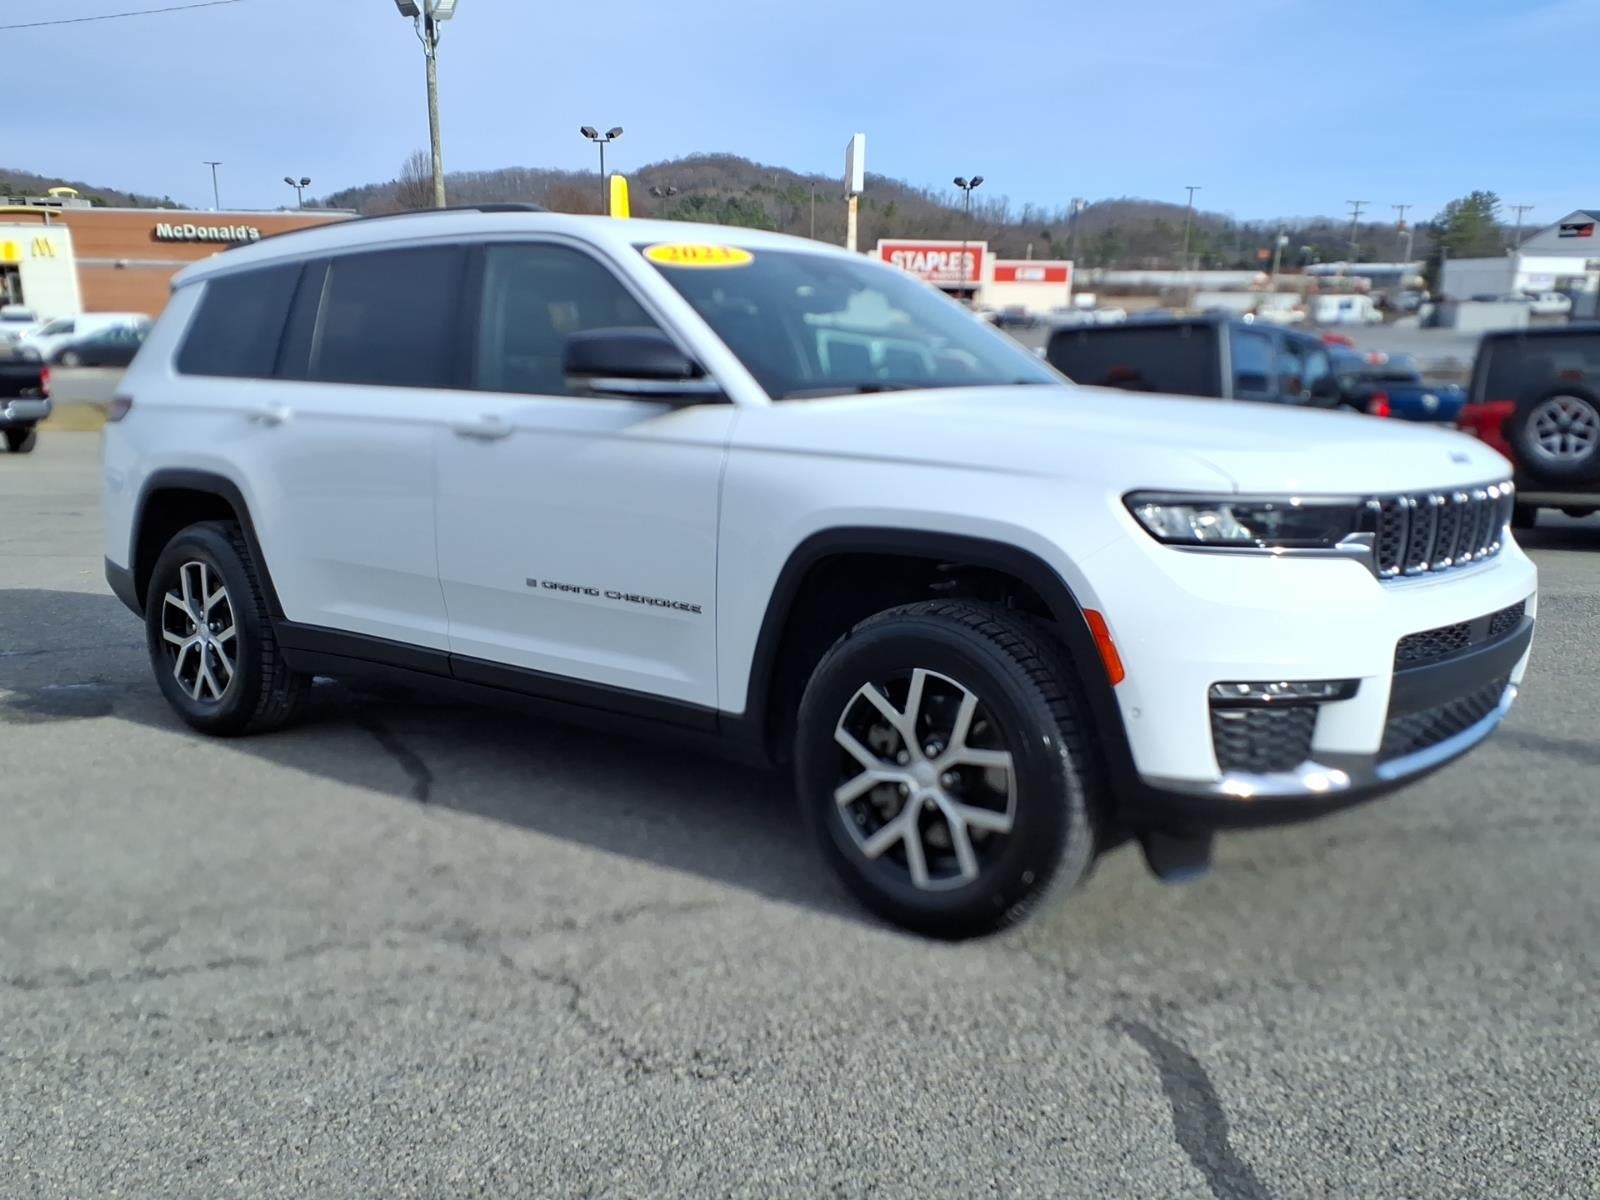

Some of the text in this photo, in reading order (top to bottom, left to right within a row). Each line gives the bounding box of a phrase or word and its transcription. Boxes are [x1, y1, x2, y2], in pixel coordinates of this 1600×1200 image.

[155, 222, 261, 241] McDonald's
[890, 250, 975, 273] STAPLES
[541, 580, 702, 614] GRAND CHEROKEE
